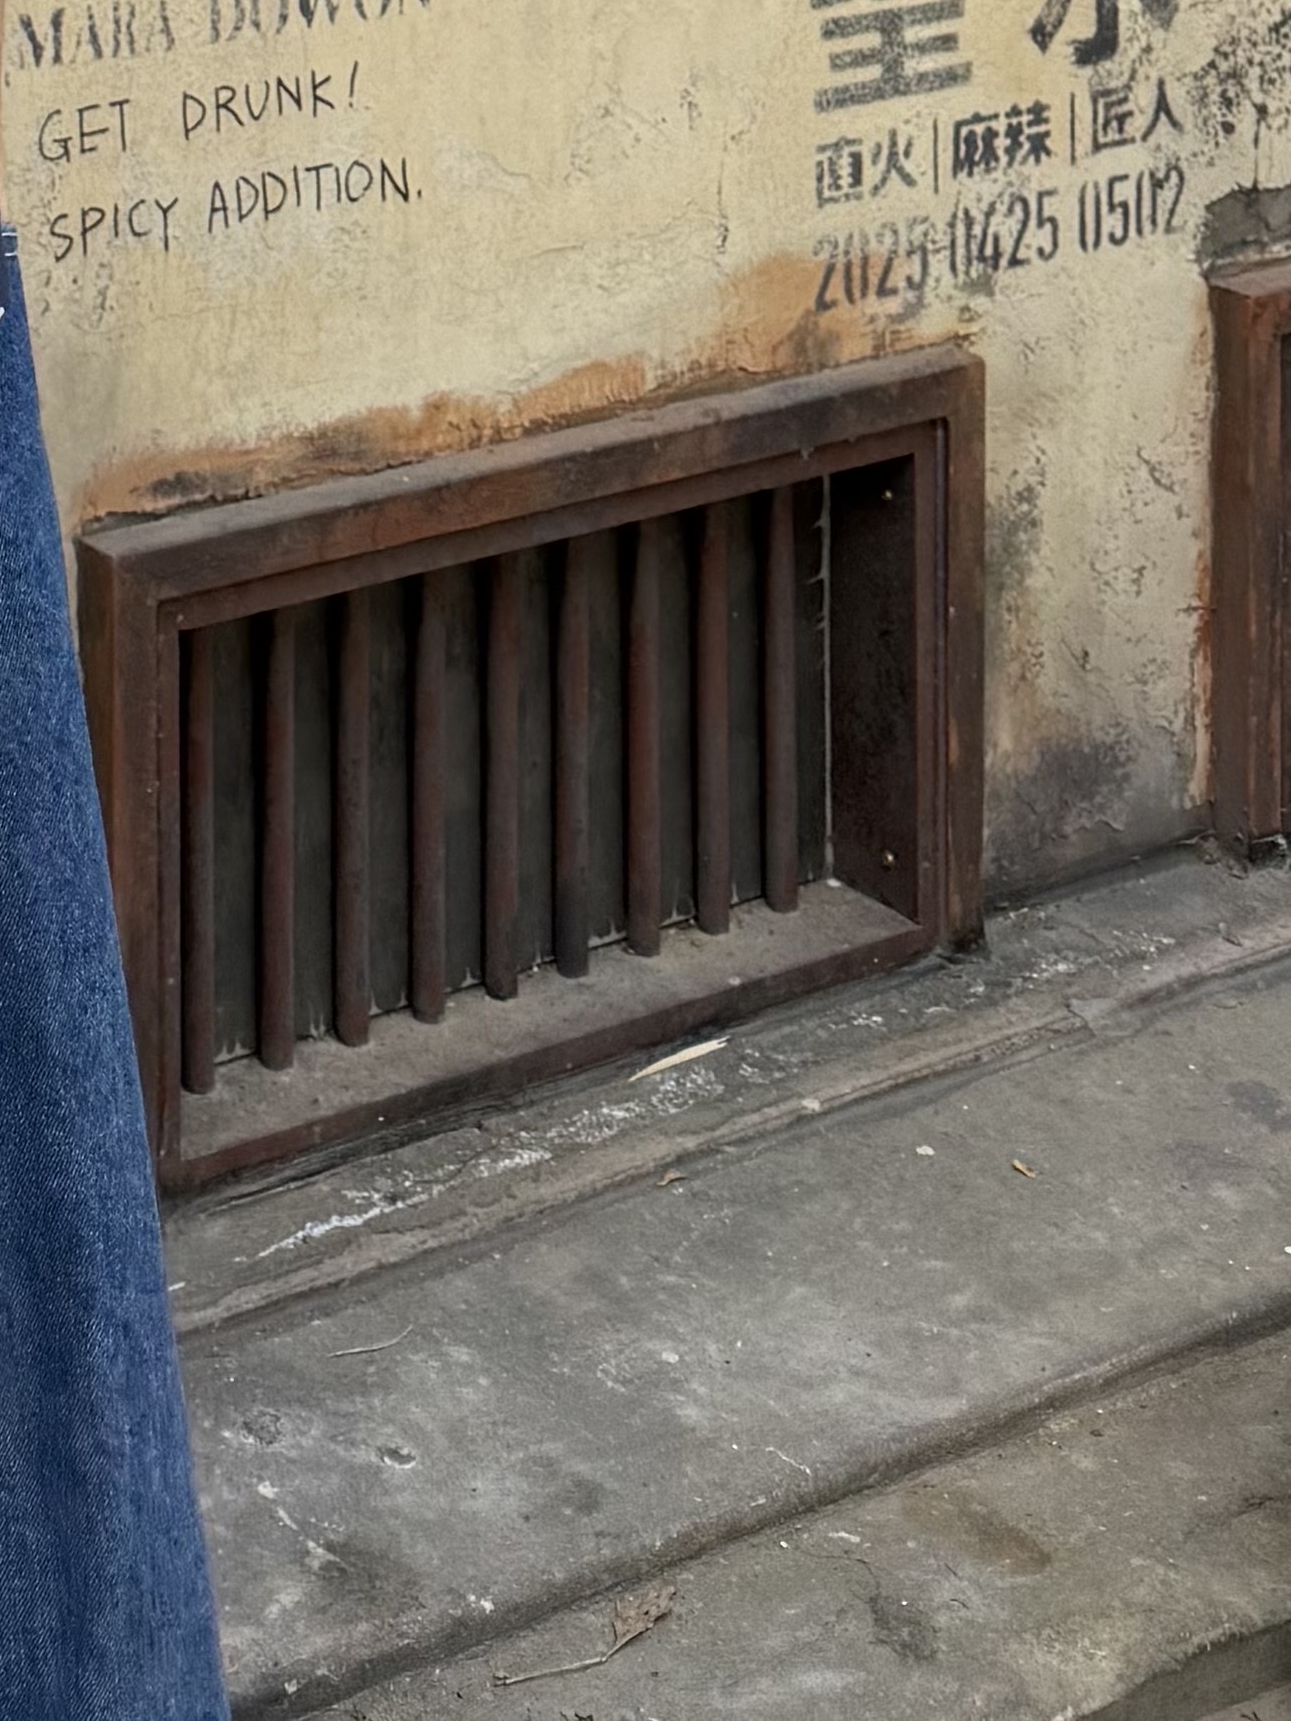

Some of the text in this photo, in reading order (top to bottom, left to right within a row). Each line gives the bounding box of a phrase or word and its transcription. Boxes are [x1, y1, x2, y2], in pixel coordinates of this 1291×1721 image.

[38, 61, 360, 163] GET DRUNK!
[48, 157, 424, 263] SPICY ADDITION.
